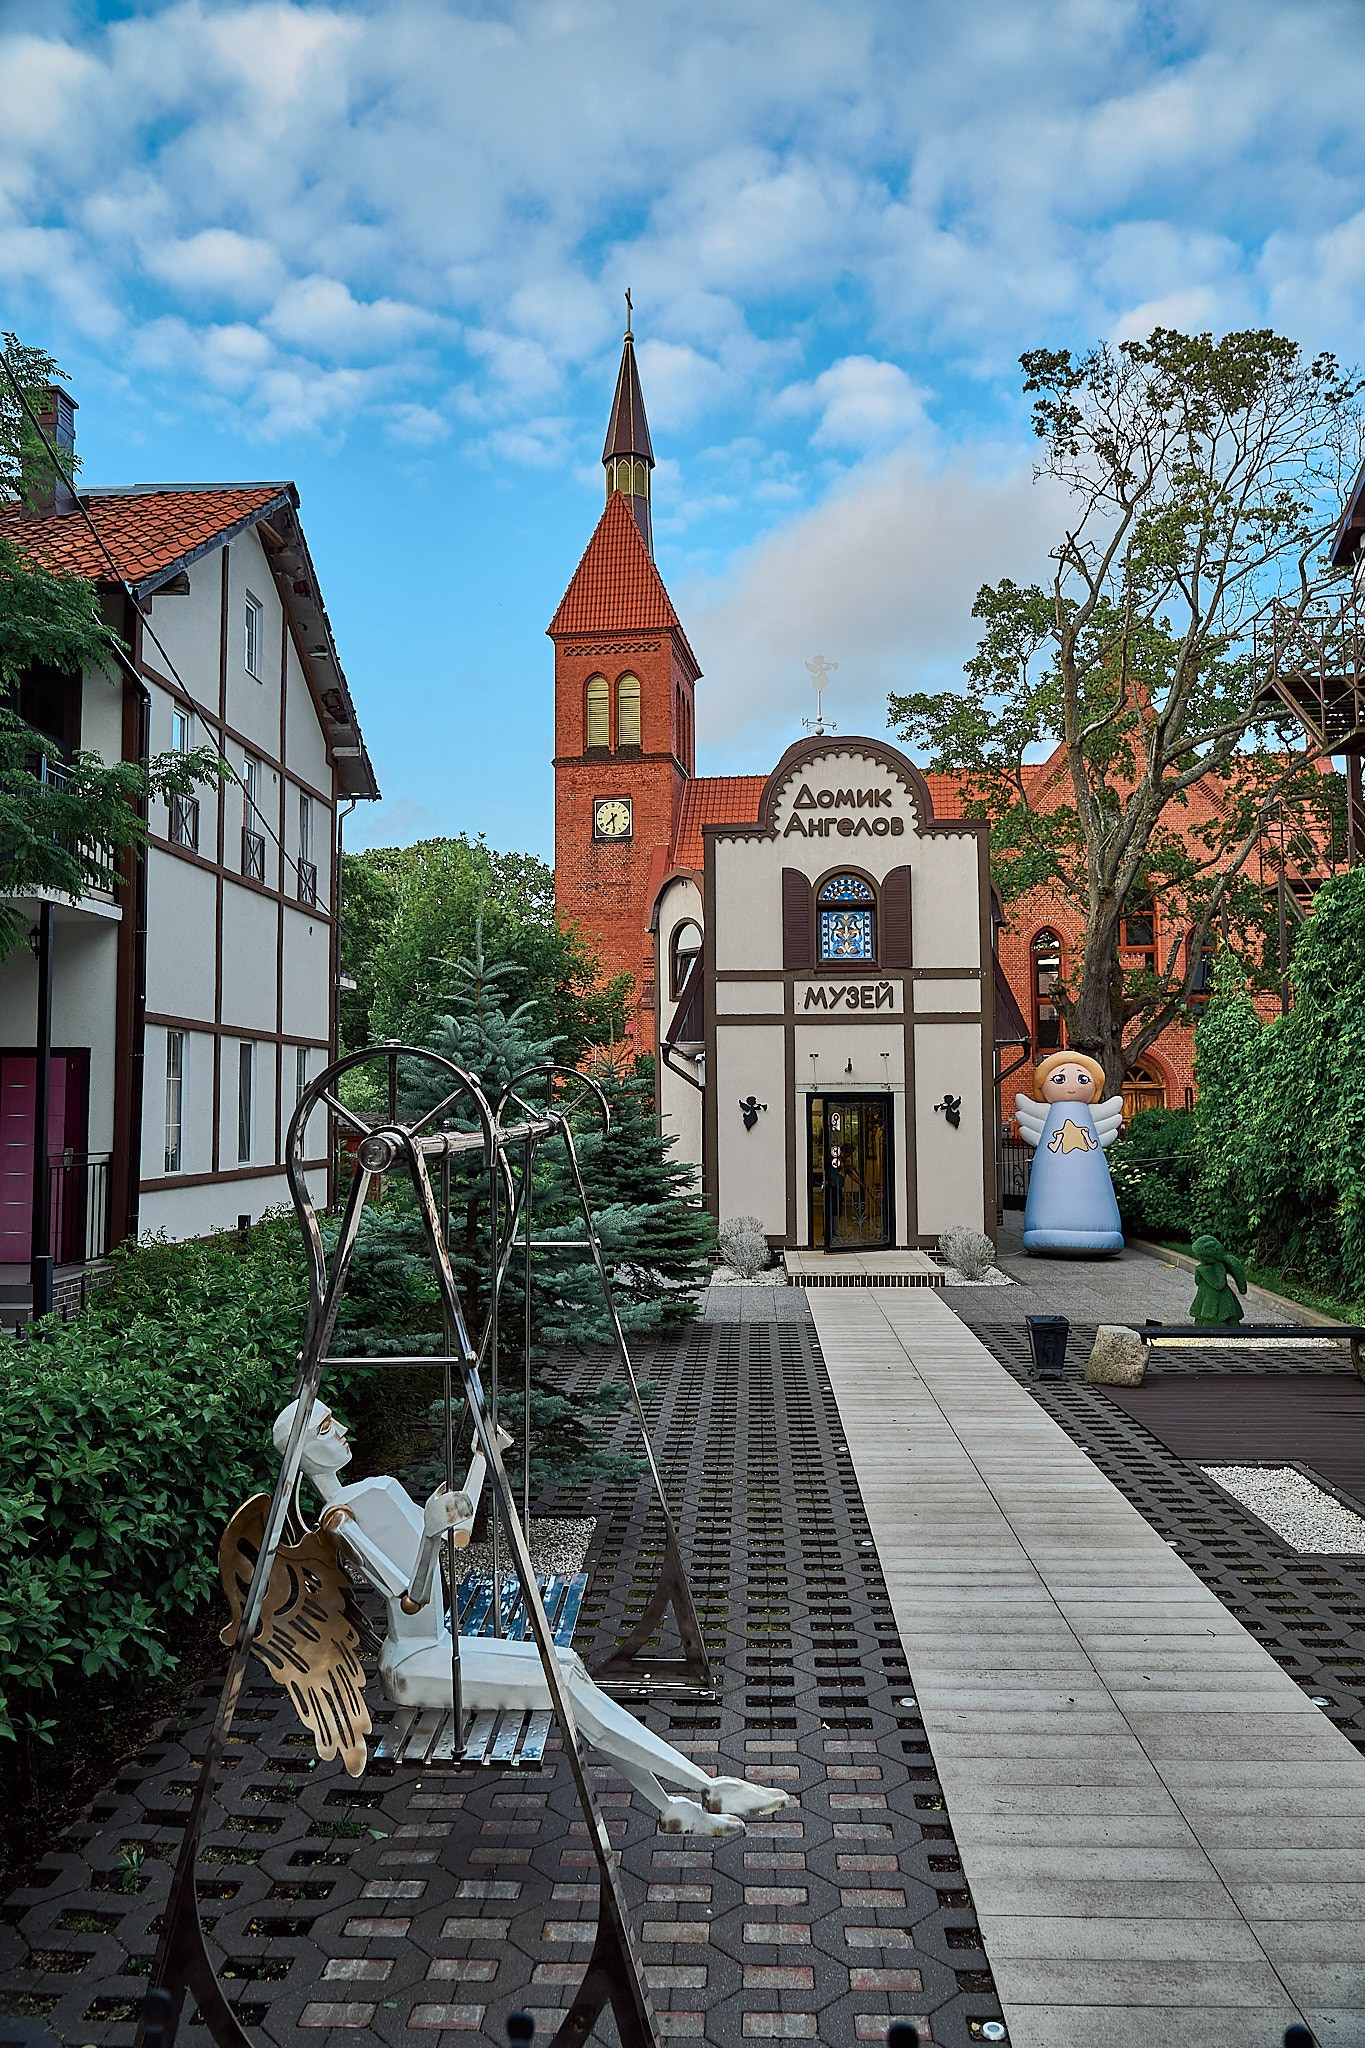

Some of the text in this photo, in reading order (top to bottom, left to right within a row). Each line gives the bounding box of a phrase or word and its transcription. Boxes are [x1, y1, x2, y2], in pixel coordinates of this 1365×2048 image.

[793, 783, 892, 809] Домик
[783, 812, 904, 837] Ангелов
[804, 982, 894, 1009] МУЗЕЙ
